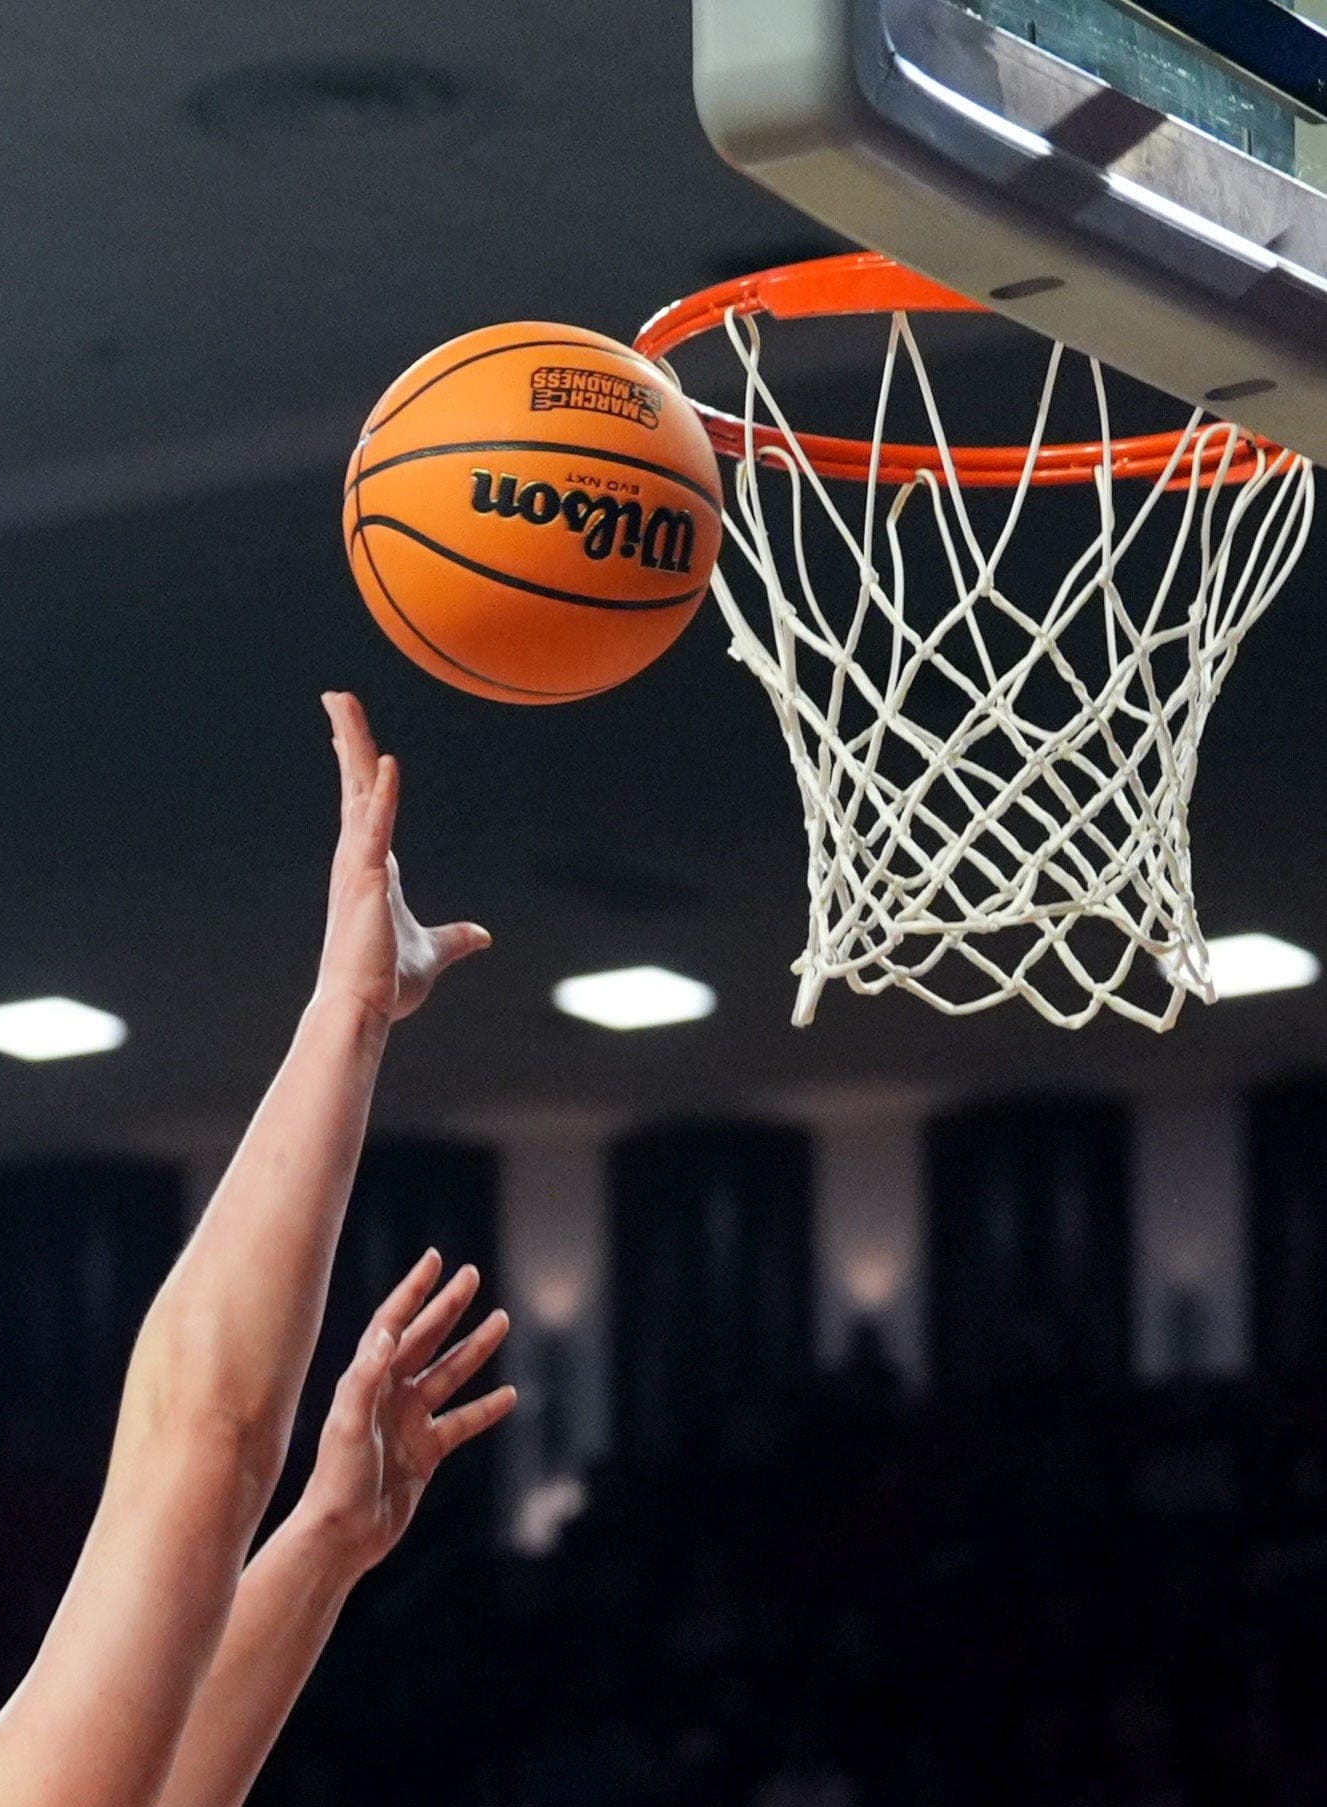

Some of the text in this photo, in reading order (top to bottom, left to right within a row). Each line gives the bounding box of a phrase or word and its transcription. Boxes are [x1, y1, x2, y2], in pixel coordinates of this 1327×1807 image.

[533, 371, 629, 397] MADNESS
[571, 391, 640, 422] MARCH
[565, 472, 640, 495] EVO NXT
[471, 468, 695, 573] Wilson
